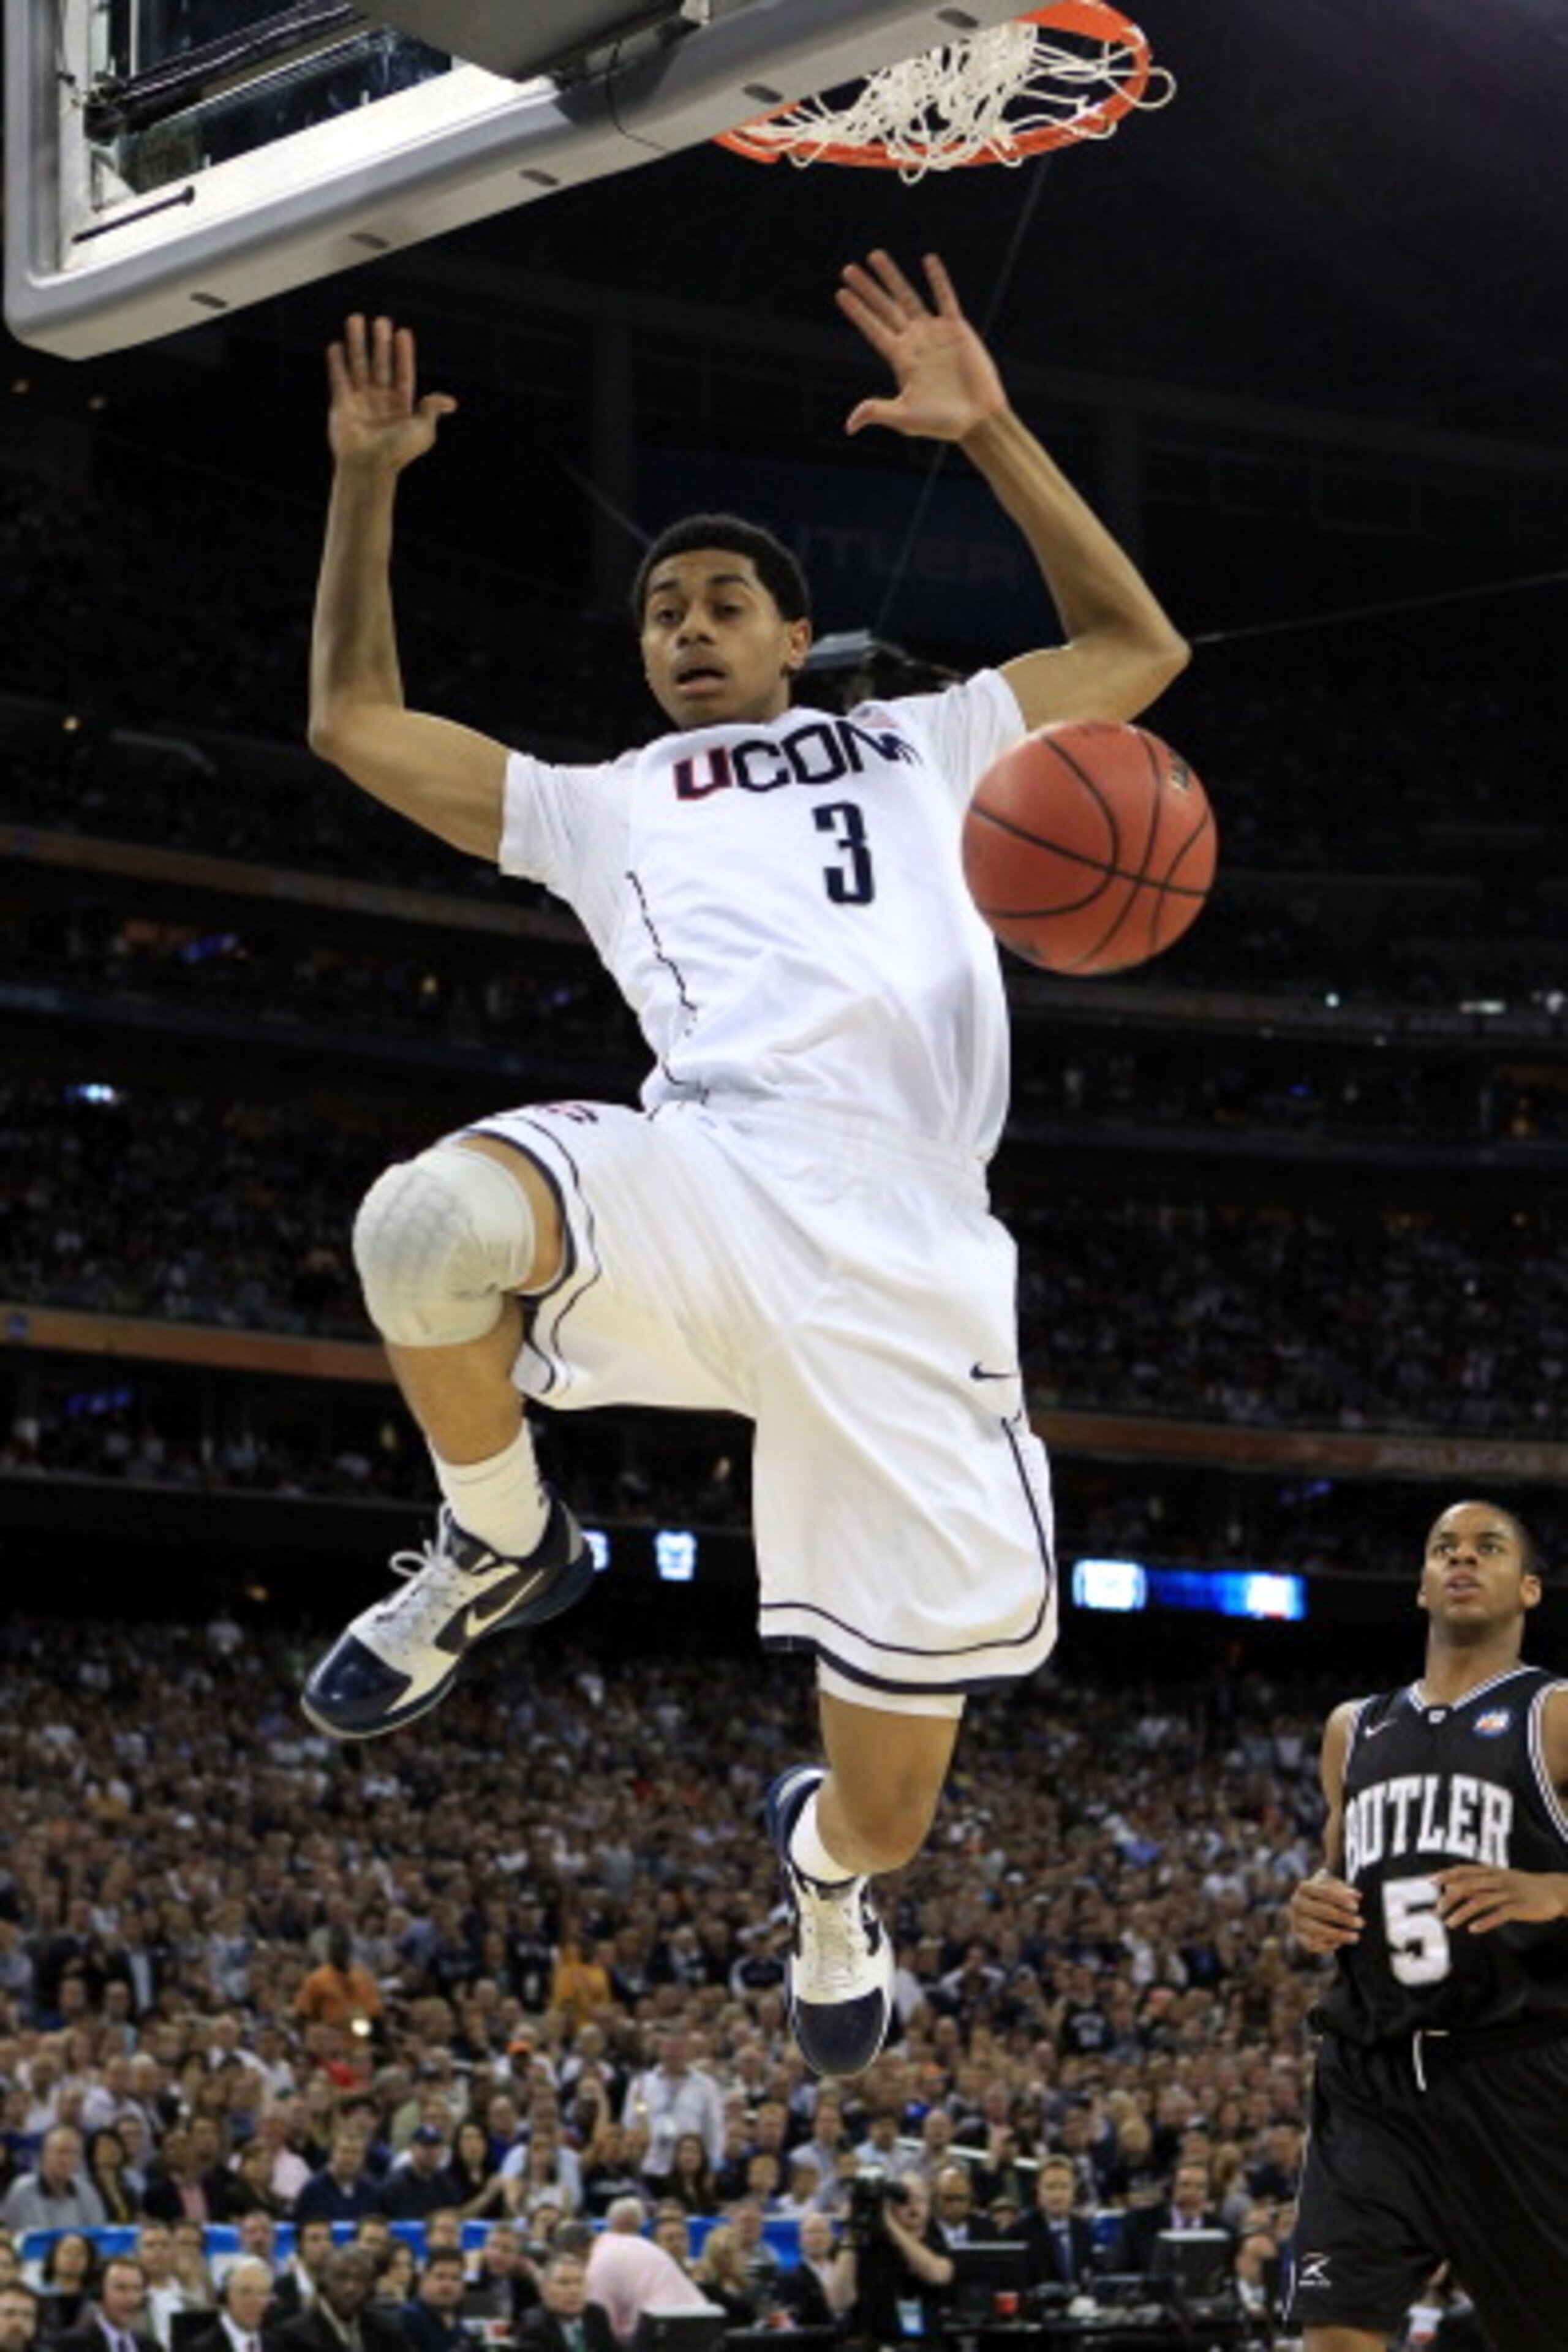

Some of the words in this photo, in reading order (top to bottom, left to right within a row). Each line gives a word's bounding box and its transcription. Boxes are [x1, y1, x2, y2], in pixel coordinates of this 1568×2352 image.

[813, 802, 874, 905] 3
[1345, 1774, 1513, 1885] BUTLER
[1382, 1875, 1450, 1986] 5
